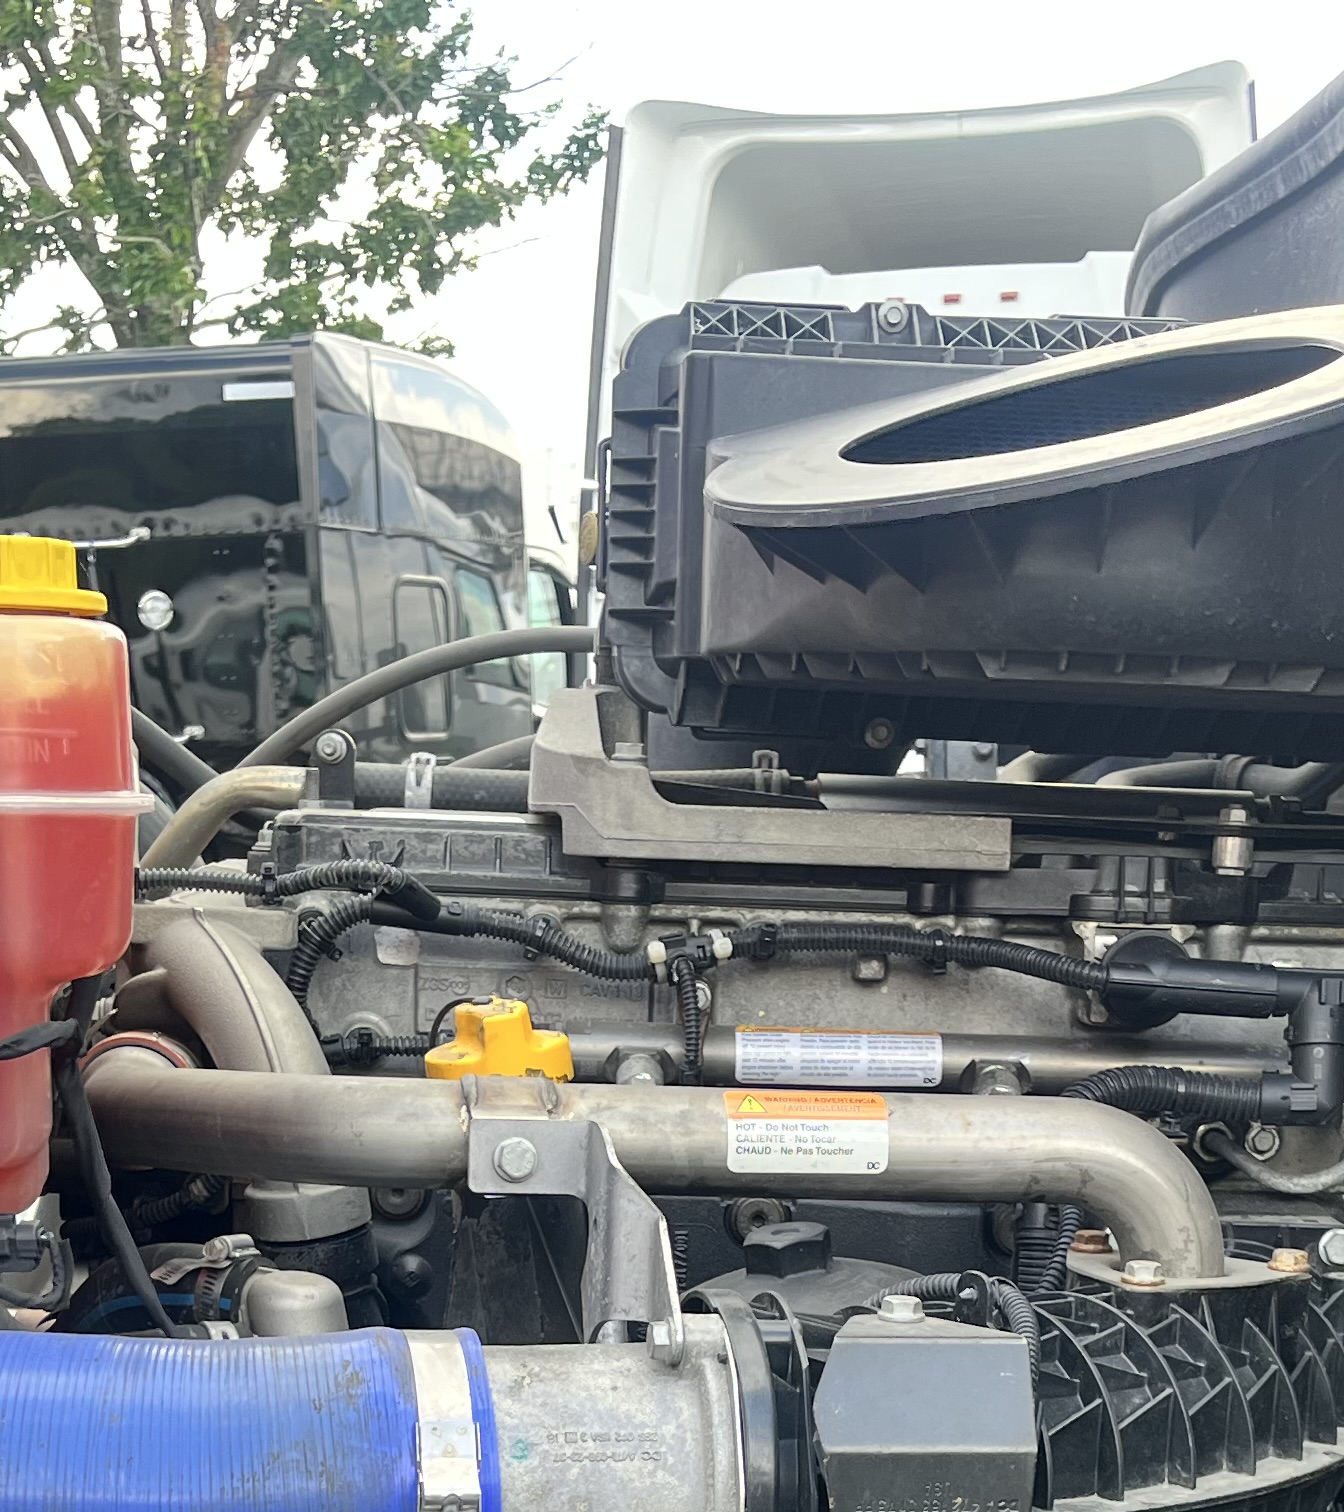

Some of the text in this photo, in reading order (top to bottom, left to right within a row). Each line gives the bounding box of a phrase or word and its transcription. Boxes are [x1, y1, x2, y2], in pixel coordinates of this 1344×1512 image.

[736, 1123, 756, 1131] HOT
[766, 1123, 779, 1131] Do
[782, 1123, 799, 1131] Not
[801, 1123, 829, 1131] Touch
[736, 1135, 786, 1143] CALIENTE
[795, 1135, 809, 1143] No
[811, 1135, 836, 1143] Tocar
[736, 1146, 771, 1155] CHAUD
[781, 1147, 794, 1155] Ne
[796, 1147, 813, 1155] Pas
[816, 1147, 854, 1155] Toucher
[867, 1162, 880, 1170] DC
